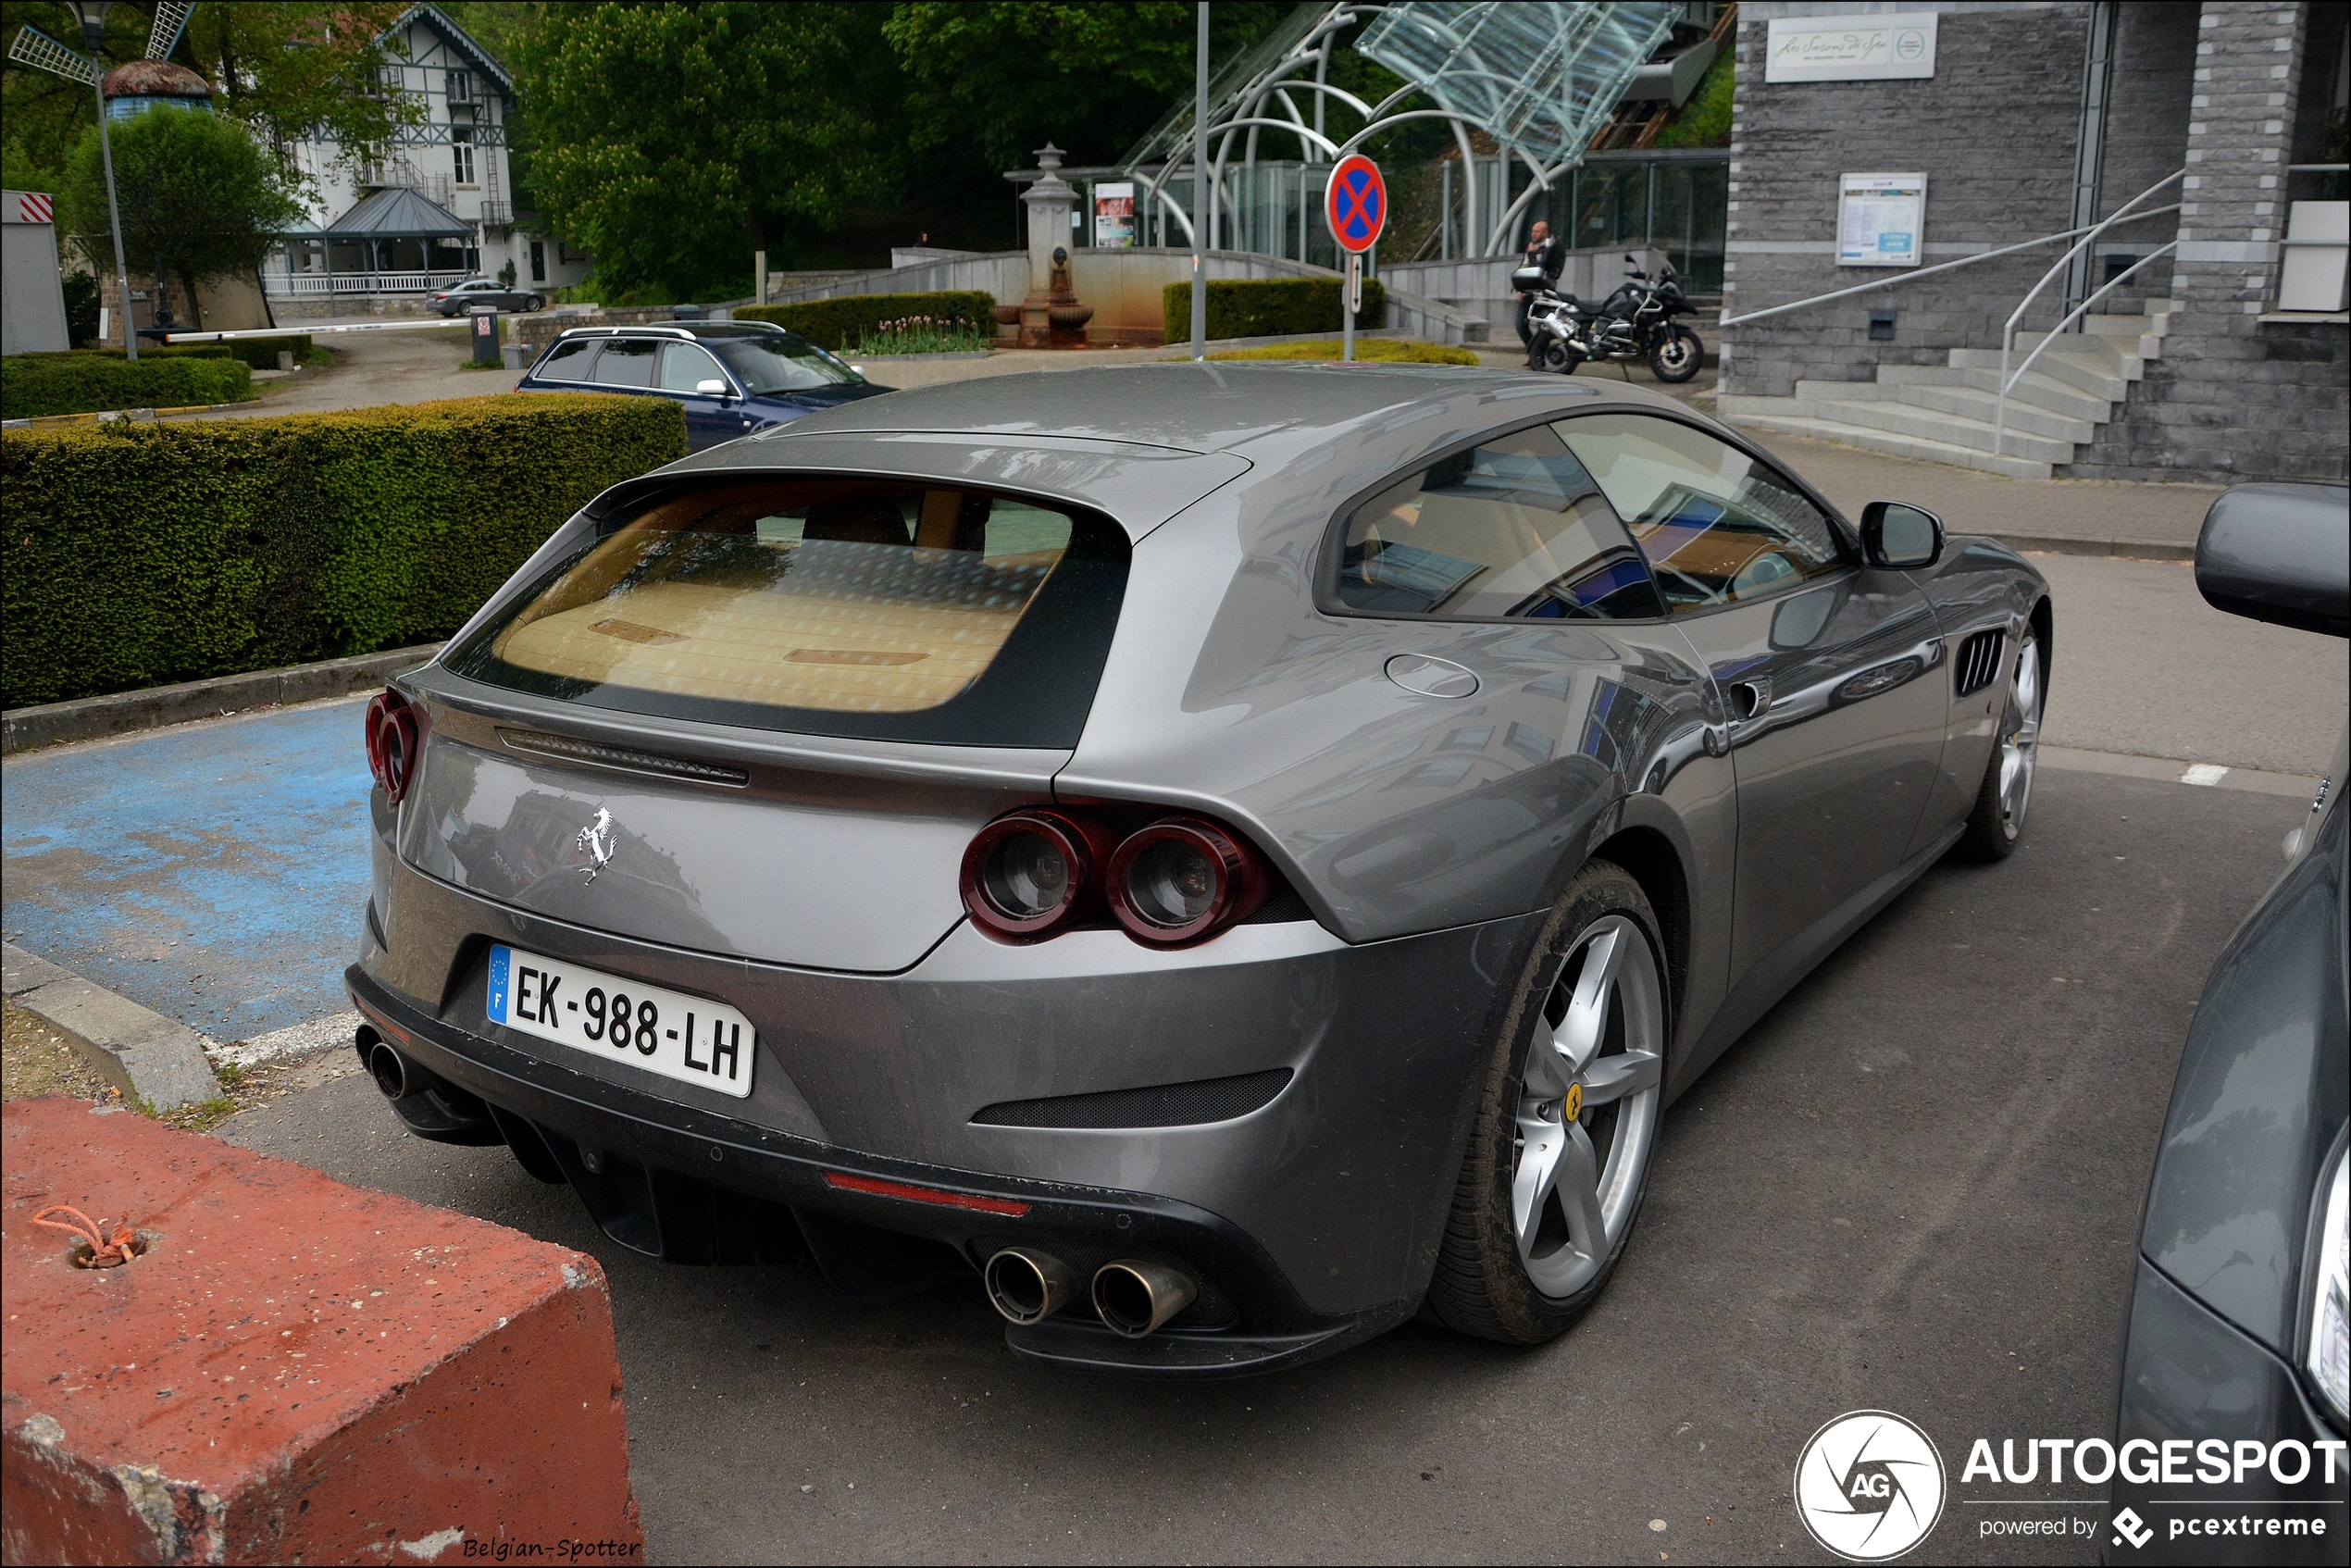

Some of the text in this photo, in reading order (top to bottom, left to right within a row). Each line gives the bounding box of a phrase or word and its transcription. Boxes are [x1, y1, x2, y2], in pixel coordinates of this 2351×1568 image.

[1860, 31, 1885, 61] Spa
[494, 993, 502, 1008] F
[516, 965, 740, 1079] EK-988-LH
